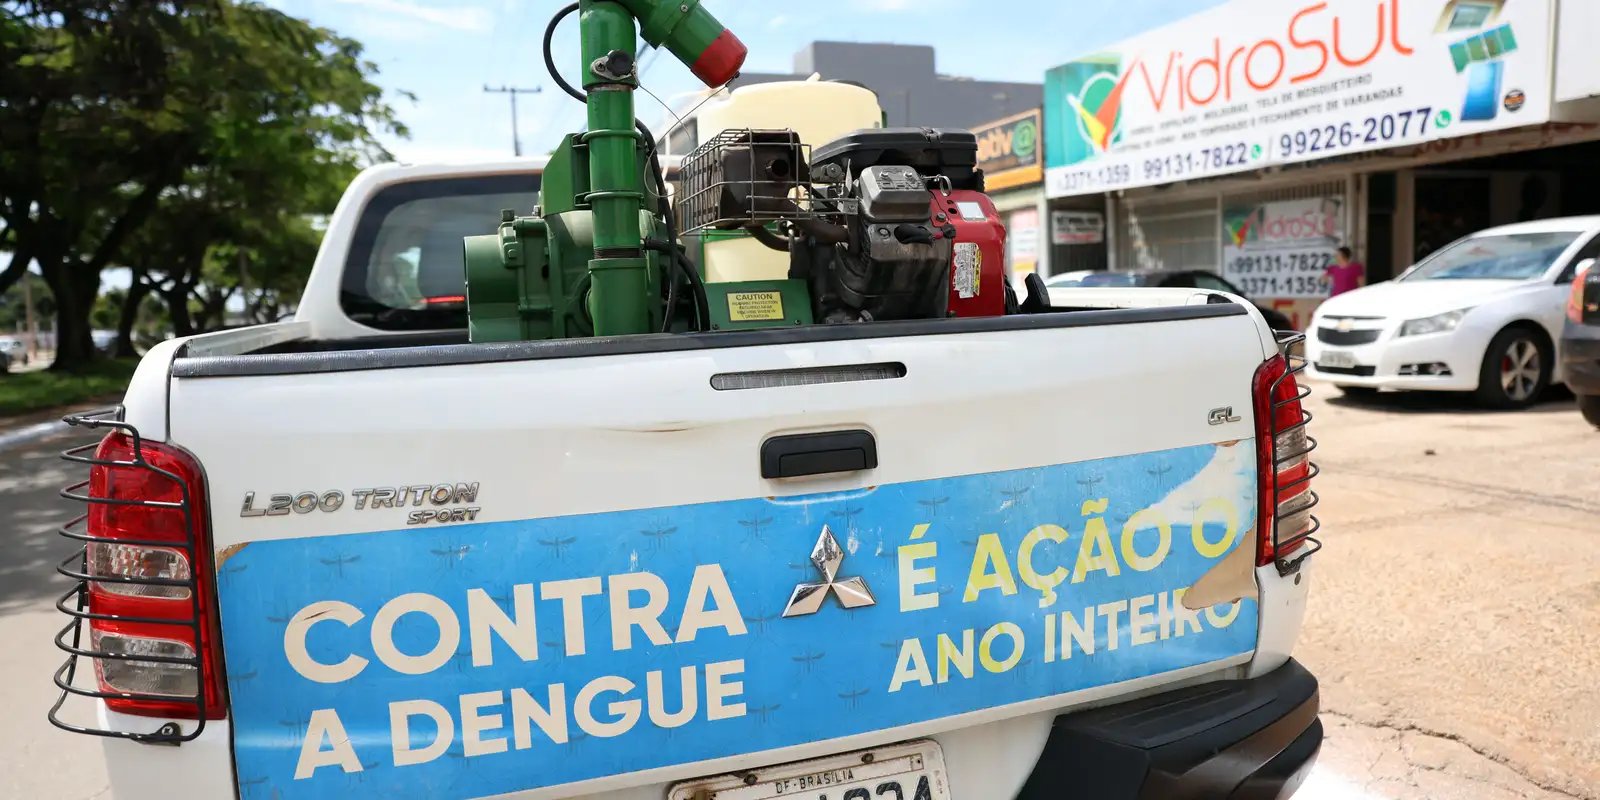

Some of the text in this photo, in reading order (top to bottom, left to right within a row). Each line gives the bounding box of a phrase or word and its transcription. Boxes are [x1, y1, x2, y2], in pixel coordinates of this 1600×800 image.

[1143, 142, 1247, 179] 99131-7822
[1280, 106, 1431, 157] 99226-2077
[735, 293, 773, 301] CAUTION
[1207, 406, 1241, 425] GL
[240, 482, 480, 518] L200 TRITON
[406, 507, 481, 525] SPORT
[898, 498, 1238, 612] É AÇÃO O
[284, 563, 748, 683] CONTRA
[888, 622, 1026, 693] ANO
[293, 658, 748, 780] A DENGUE
